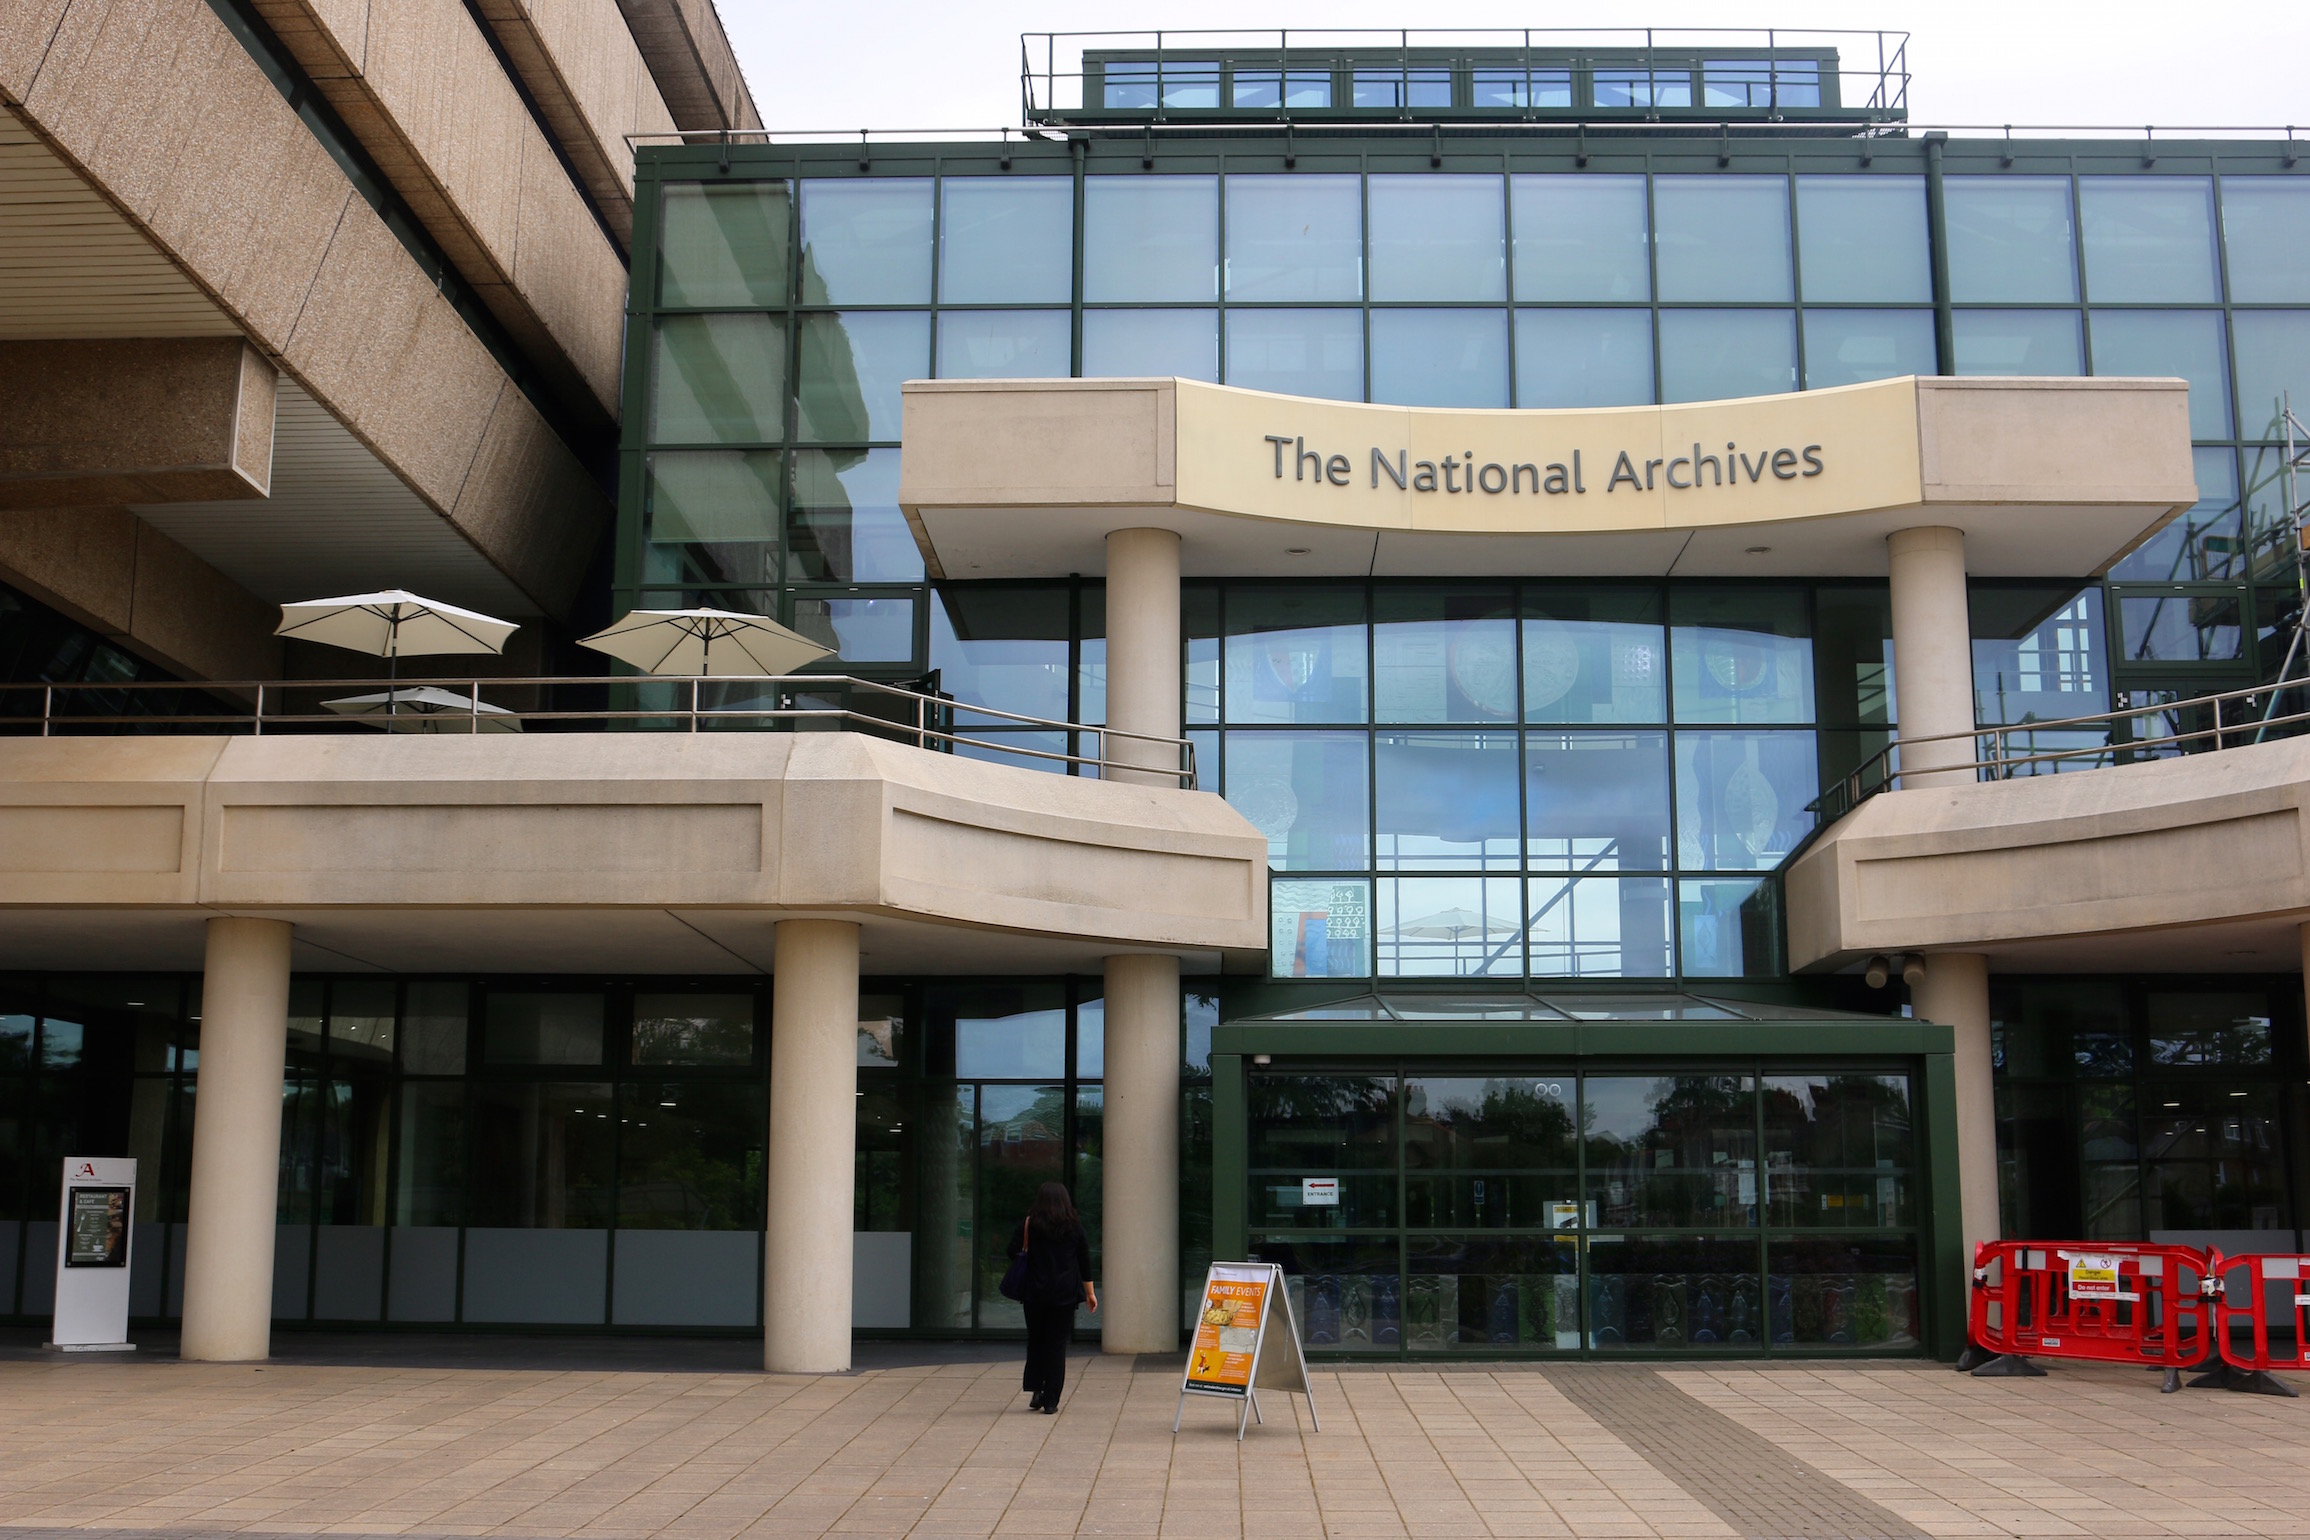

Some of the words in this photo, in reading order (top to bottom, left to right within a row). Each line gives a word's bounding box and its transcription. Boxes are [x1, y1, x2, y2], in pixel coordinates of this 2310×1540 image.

[1265, 434, 1351, 487] The
[1371, 447, 1586, 495] National
[1608, 441, 1824, 492] Archives
[1211, 1285, 1235, 1295] FAMILY
[1236, 1287, 1261, 1296] EVENTS
